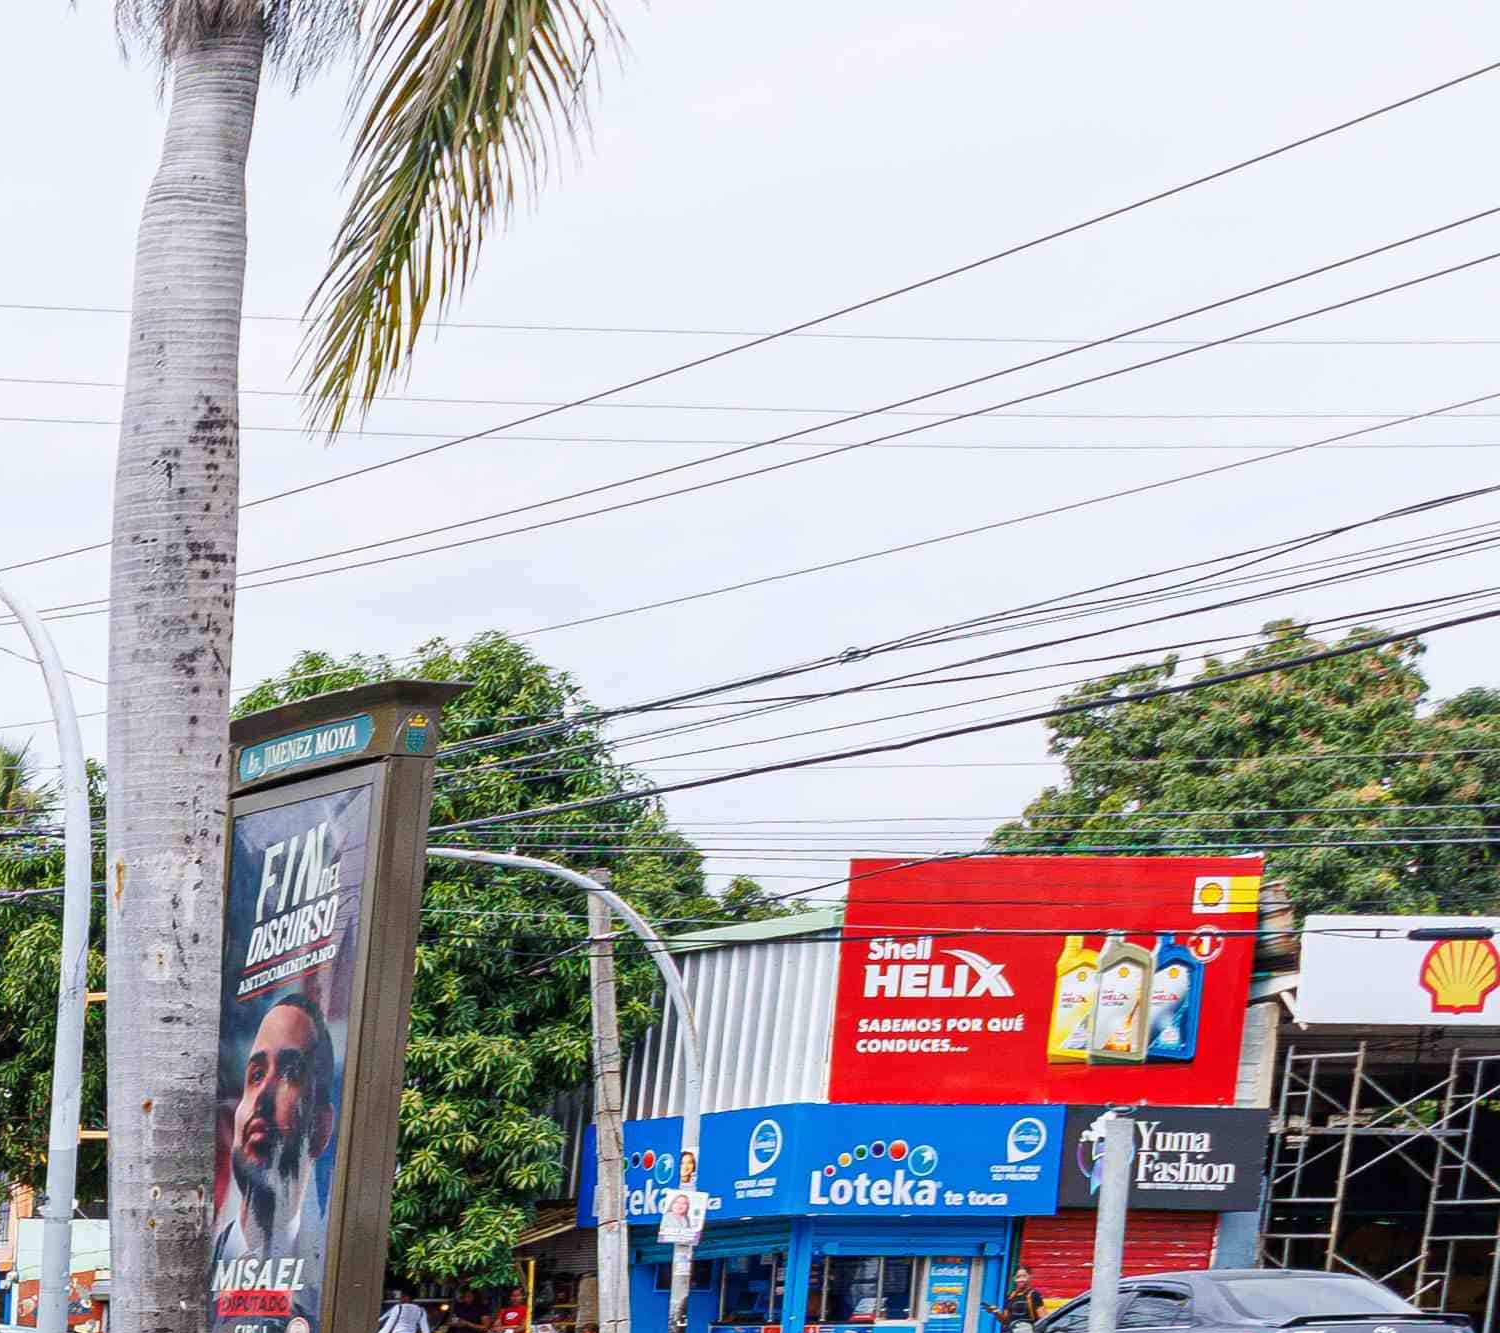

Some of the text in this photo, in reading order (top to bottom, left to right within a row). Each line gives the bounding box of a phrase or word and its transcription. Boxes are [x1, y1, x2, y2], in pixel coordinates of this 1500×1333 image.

[262, 736, 312, 771] JIMENEZ
[316, 724, 357, 755] MOYA
[255, 822, 342, 923] FIN DEL
[246, 894, 339, 967] DISCURSO
[867, 936, 933, 960] Shell
[237, 944, 337, 995] ANTIDOMINICANO
[863, 950, 1015, 998] HELIX
[858, 1013, 1026, 1032] SABEMOS POR QUÉ
[856, 1038, 970, 1053] CONDUCES...
[1135, 1121, 1212, 1152] Yuma
[1134, 1152, 1236, 1184] Fashion
[809, 1169, 1008, 1206] Loteka te toca
[211, 1258, 306, 1291] MISAEL
[221, 1295, 290, 1313] DIPUTADO
